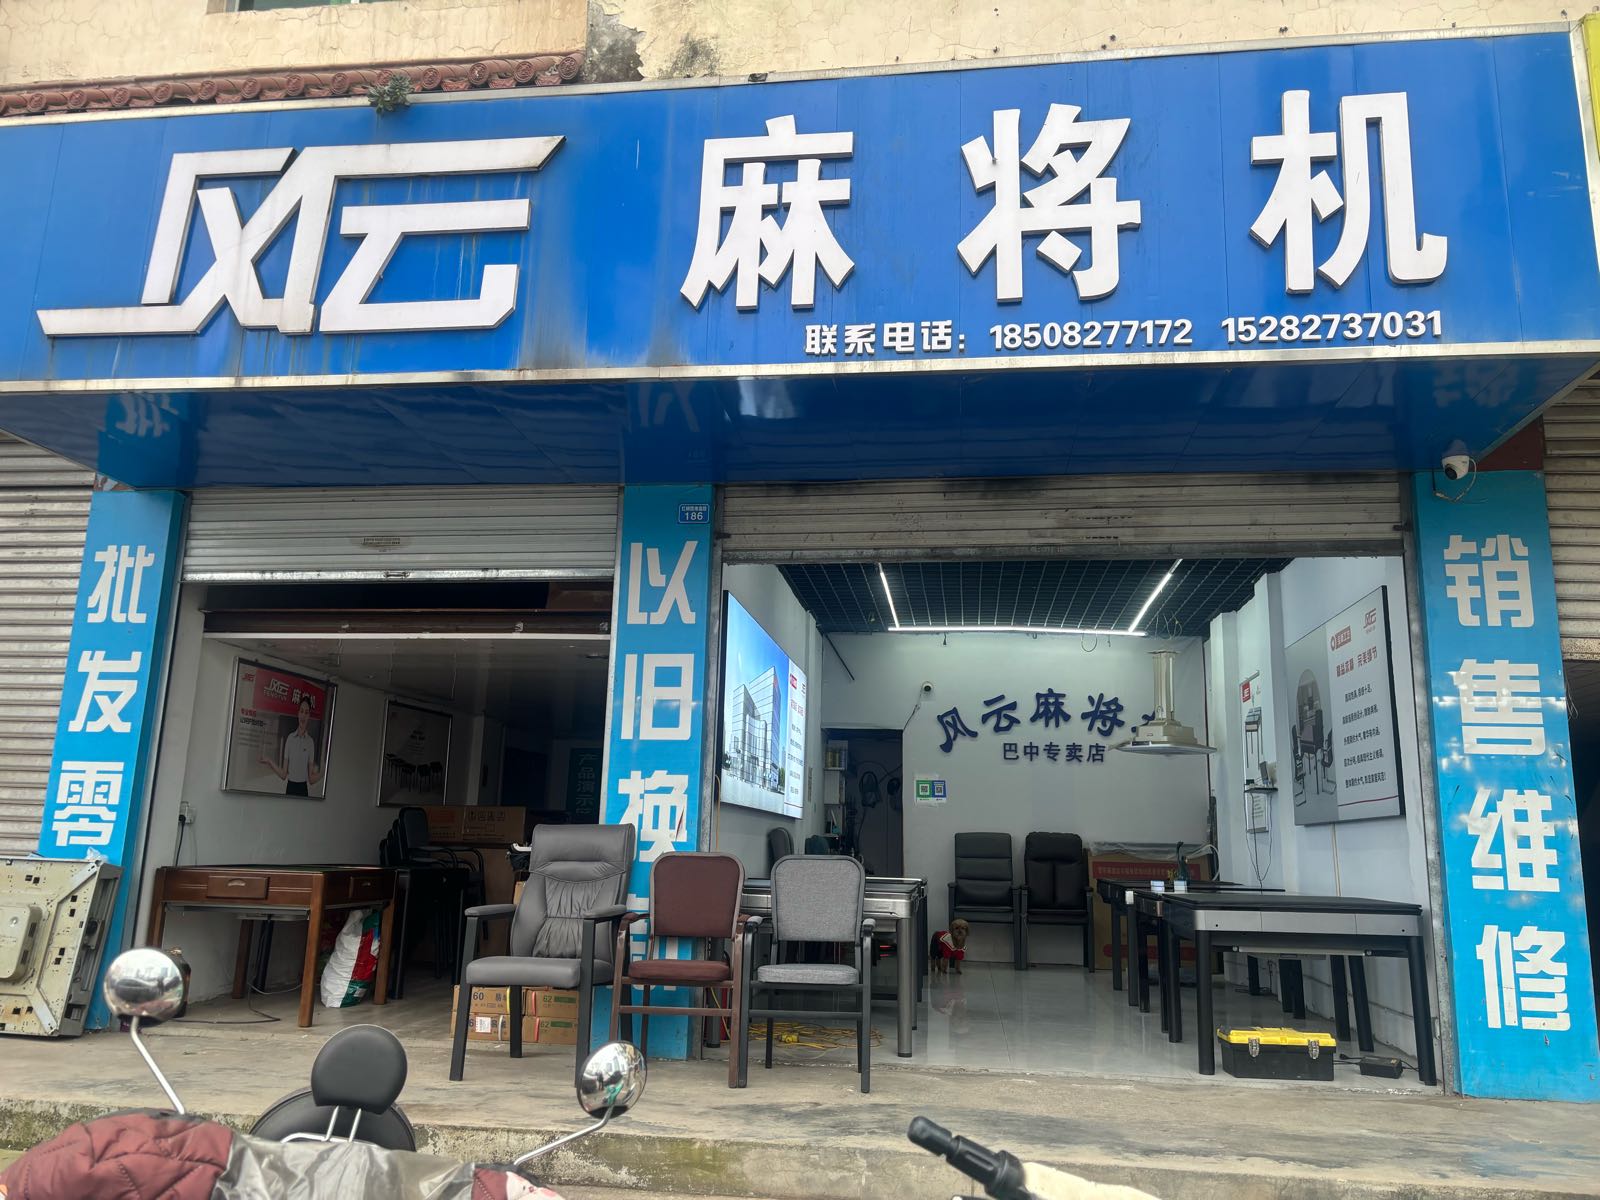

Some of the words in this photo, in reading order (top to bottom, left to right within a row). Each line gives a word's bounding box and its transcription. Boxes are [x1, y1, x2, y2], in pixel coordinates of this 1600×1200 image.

[36, 135, 566, 336] 风云
[680, 90, 1447, 309] 麻将机
[989, 318, 1193, 350] 18508277172
[1221, 310, 1442, 343] 15282737031
[685, 511, 703, 521] 186
[1003, 742, 1106, 763] 巴中专卖店
[1443, 534, 1571, 1032] 销售维修
[473, 992, 484, 1001] 60
